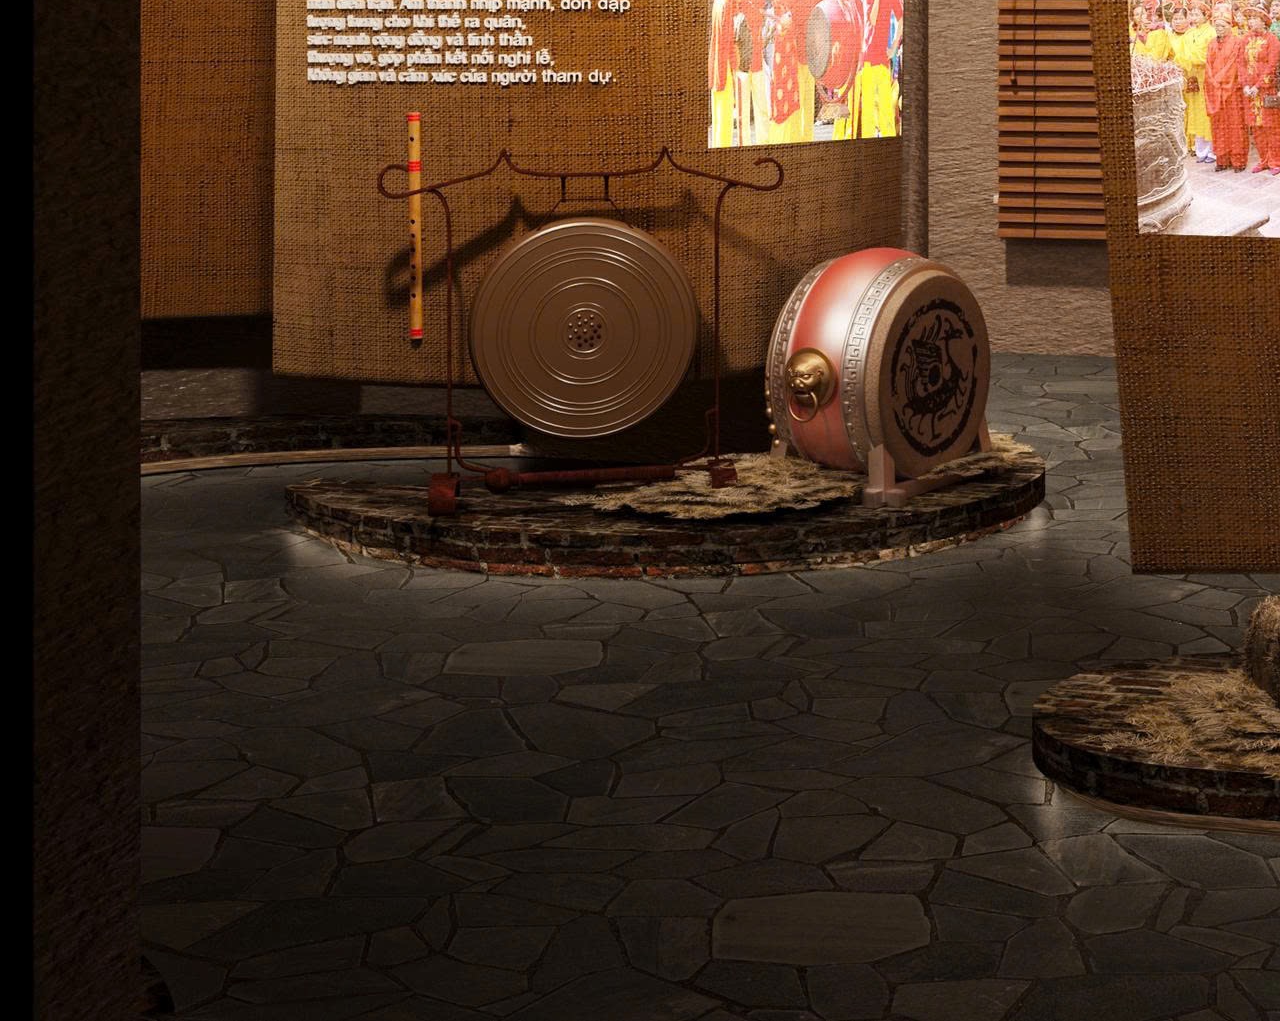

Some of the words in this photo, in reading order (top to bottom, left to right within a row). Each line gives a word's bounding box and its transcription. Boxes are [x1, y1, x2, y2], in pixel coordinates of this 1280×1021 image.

[464, 17, 481, 28] ra
[483, 14, 527, 31] quân,
[445, 32, 464, 46] và
[498, 30, 533, 47] thần
[471, 47, 494, 65] nối
[498, 51, 531, 68] nghi
[535, 48, 555, 65] lễ,
[491, 69, 537, 86] người
[541, 69, 582, 83] tham
[588, 69, 617, 85] dự.
